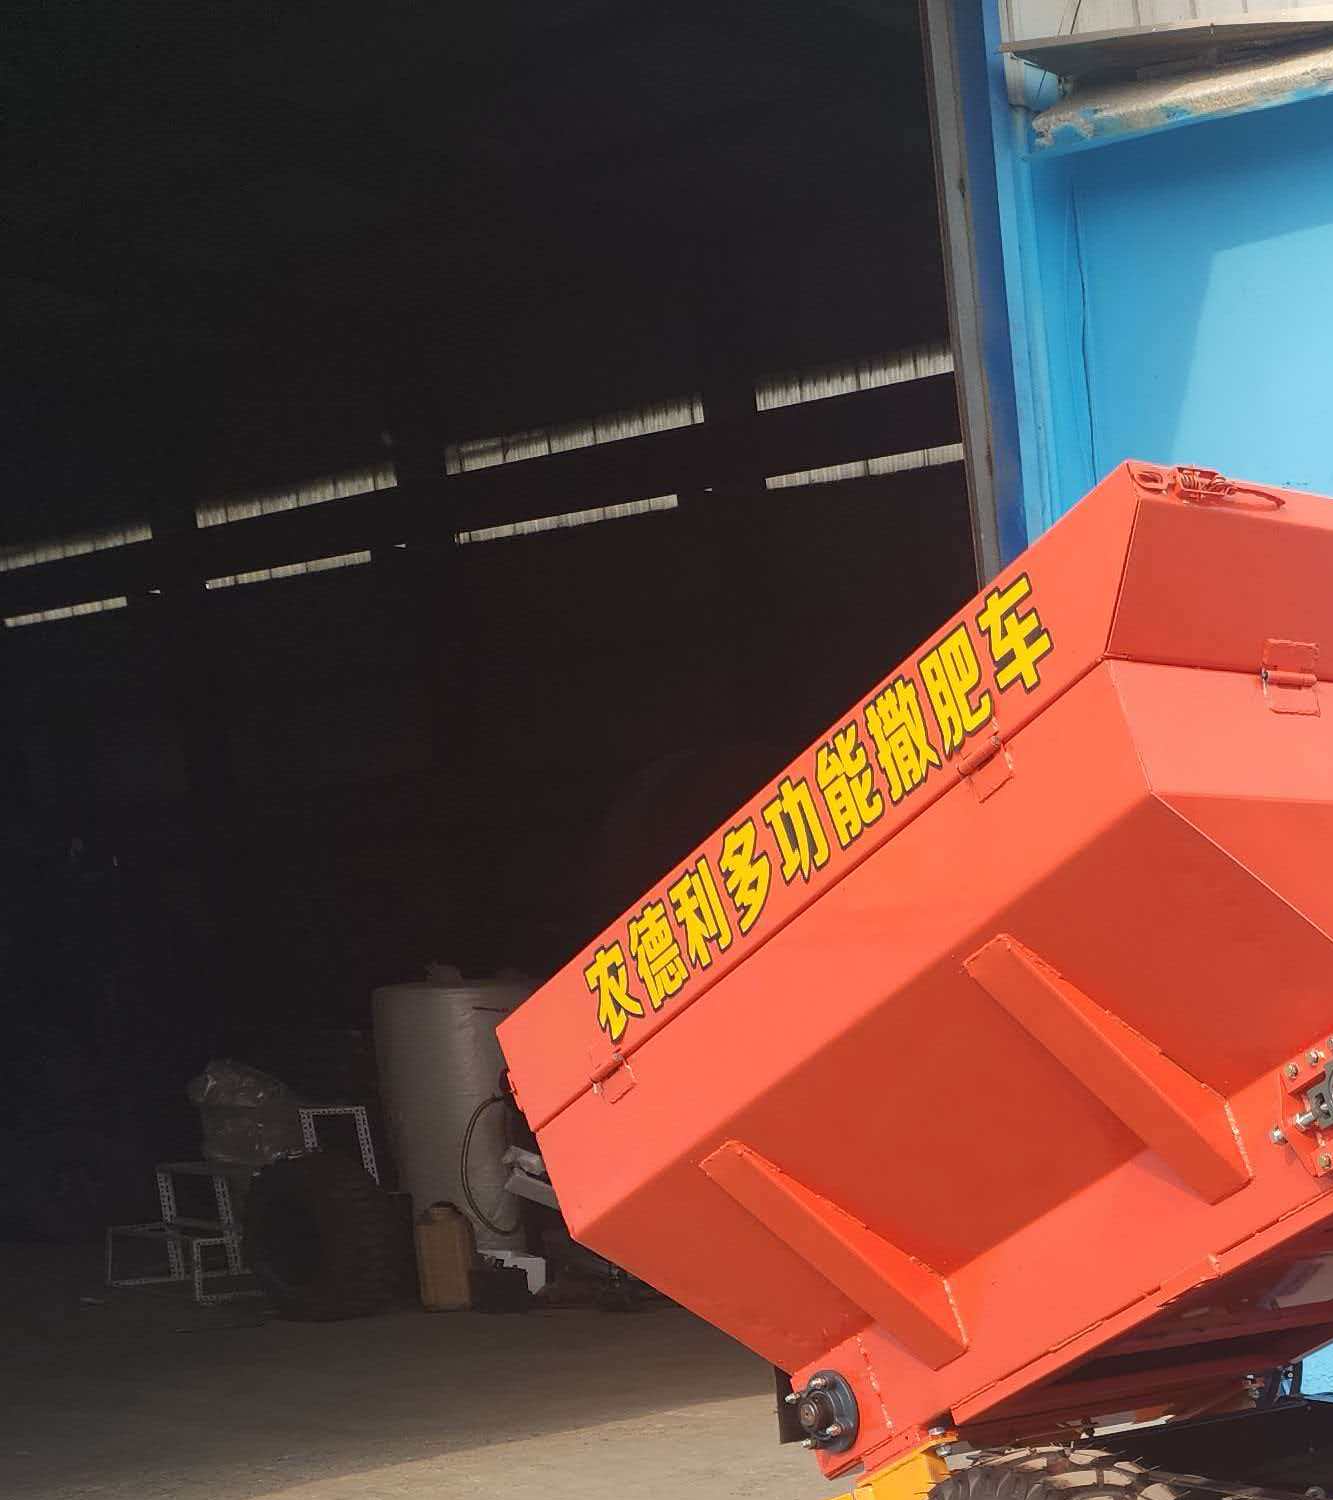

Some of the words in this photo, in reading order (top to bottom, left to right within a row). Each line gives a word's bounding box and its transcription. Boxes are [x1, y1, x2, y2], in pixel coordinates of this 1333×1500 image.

[583, 573, 1053, 1042] 农德利多功能撒肥车
